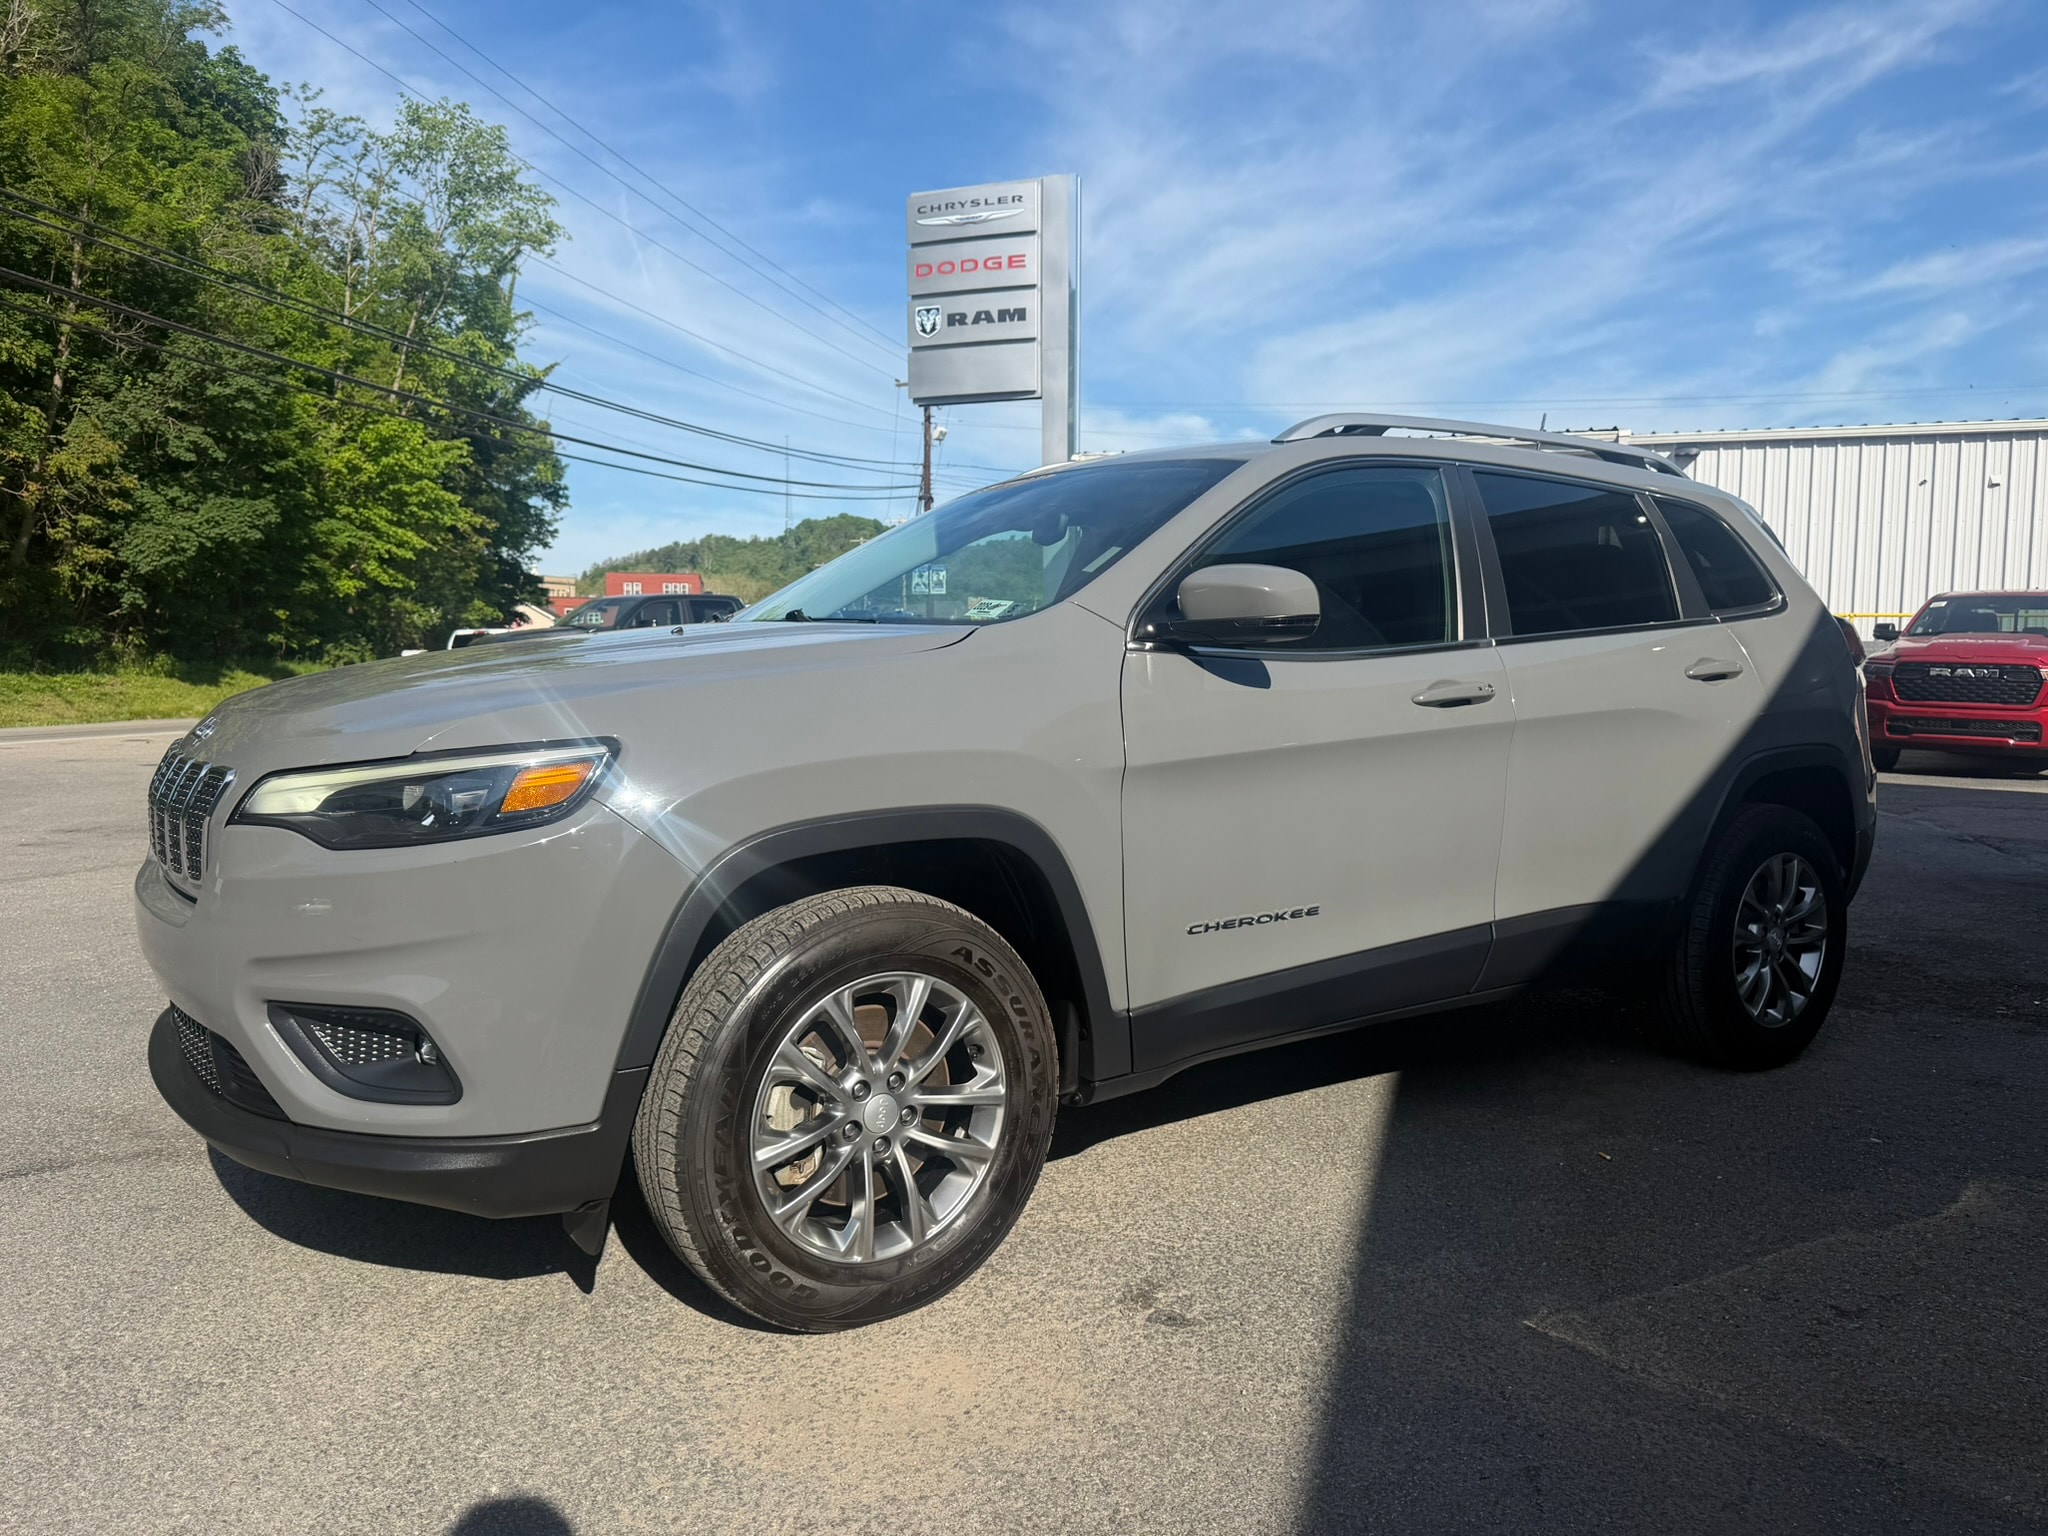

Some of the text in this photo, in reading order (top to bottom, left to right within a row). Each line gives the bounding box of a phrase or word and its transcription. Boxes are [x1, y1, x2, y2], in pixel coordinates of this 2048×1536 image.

[917, 195, 1024, 214] CHRYSLER
[915, 254, 1026, 279] DODGE
[947, 307, 1026, 327] RAM
[1929, 667, 2000, 678] RAM
[1186, 905, 1321, 935] CHEROKEE
[951, 945, 1046, 1160] ASSURANCE
[713, 1076, 820, 1300] GOODYEAR
